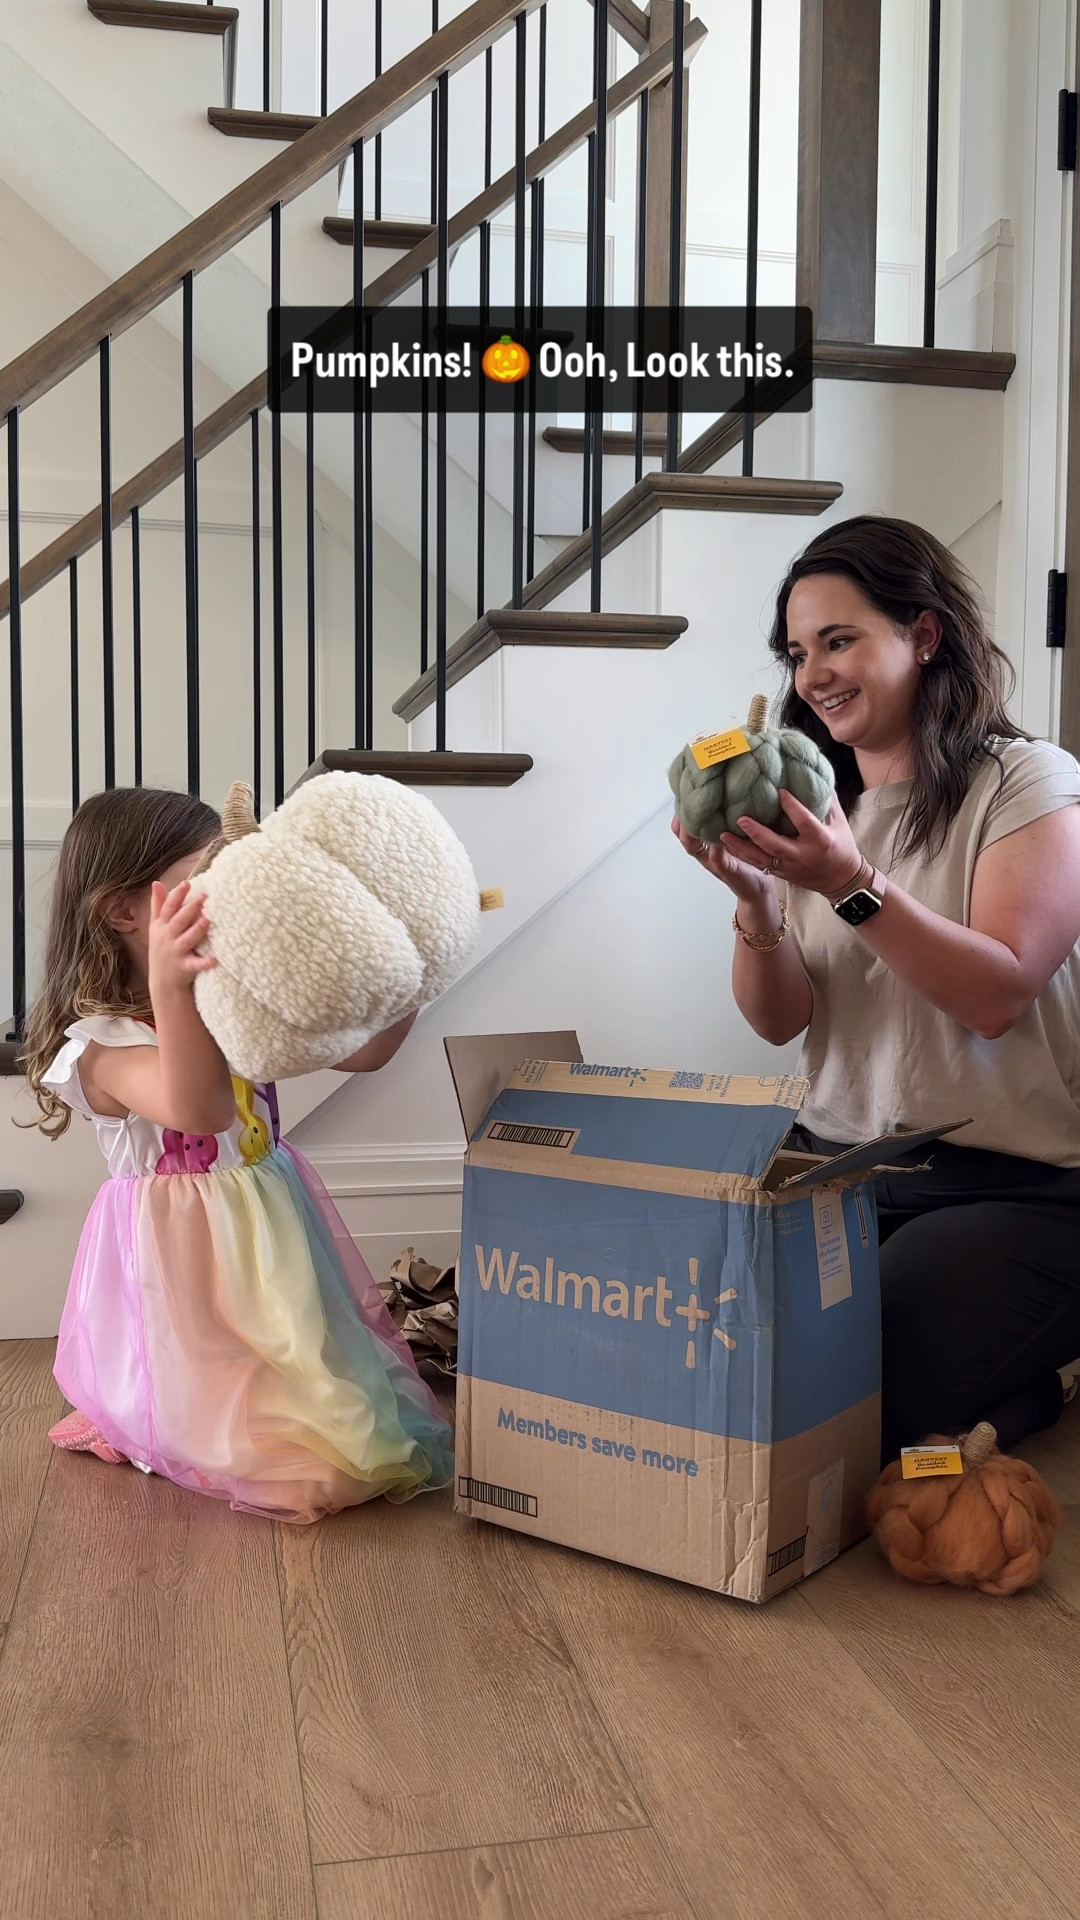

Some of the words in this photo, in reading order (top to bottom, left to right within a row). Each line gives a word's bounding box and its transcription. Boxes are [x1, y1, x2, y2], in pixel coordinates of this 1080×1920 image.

[497, 1407, 587, 1450] Members
[591, 1436, 637, 1462] save
[641, 1448, 699, 1477] more
